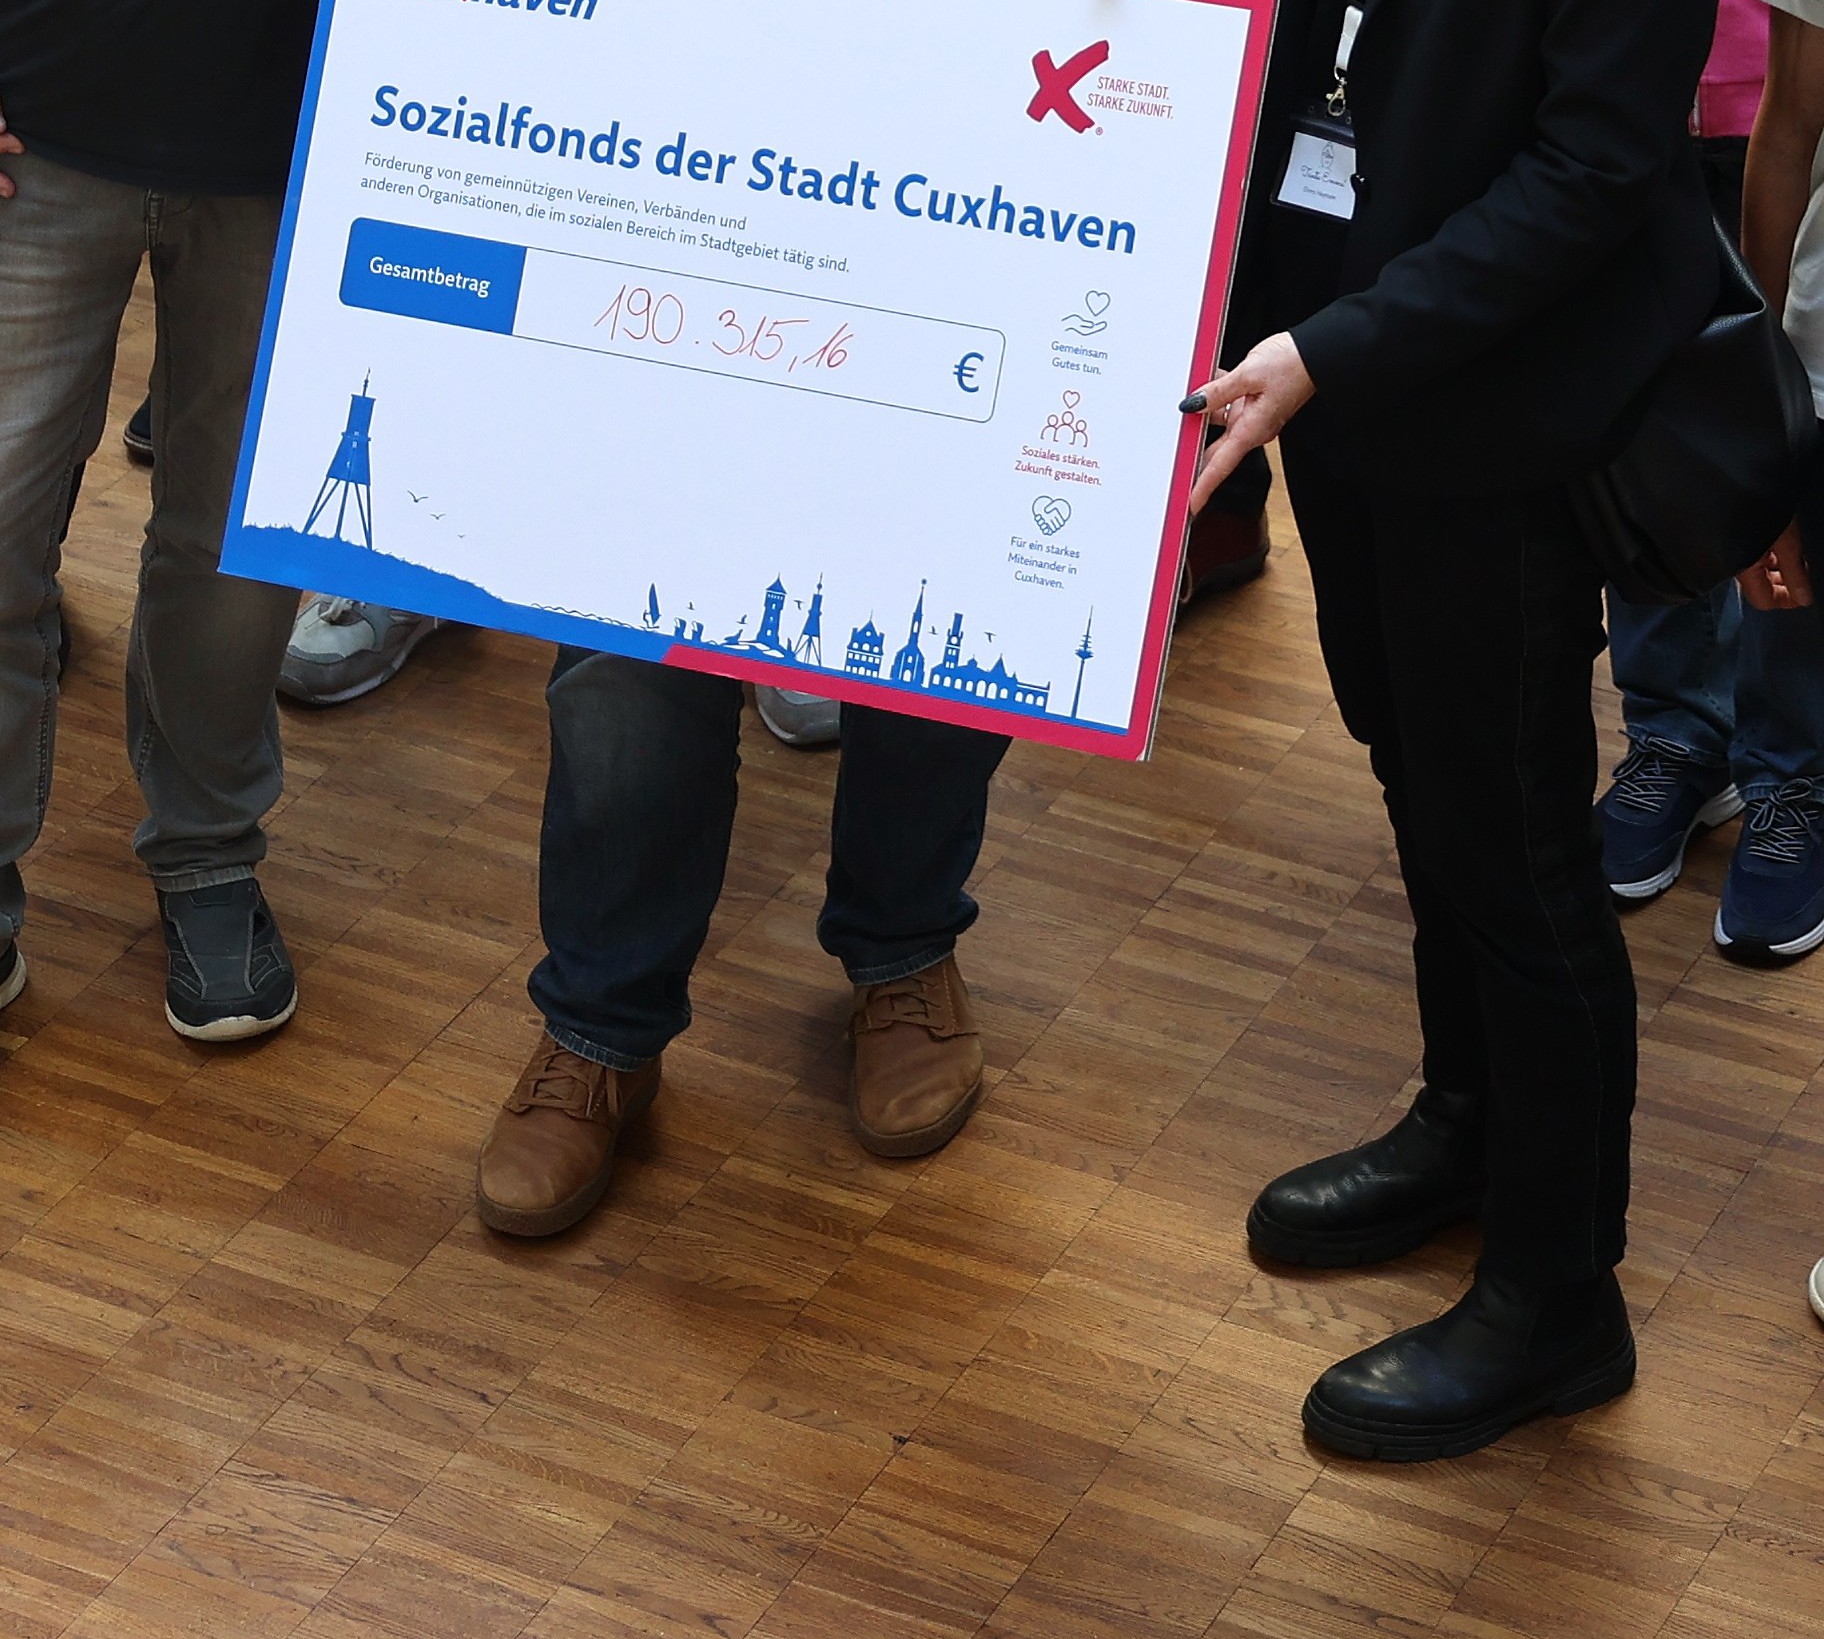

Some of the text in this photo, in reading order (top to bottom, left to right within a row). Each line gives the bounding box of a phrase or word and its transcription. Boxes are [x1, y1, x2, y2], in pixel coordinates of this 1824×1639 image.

[1097, 76, 1170, 100] STARKE STADT.
[1086, 93, 1174, 119] STARKE ZUKUNFT.
[370, 84, 1137, 254] Sozialfonds der Stadt Cuxhaven
[364, 152, 747, 231] Förderung von gemeinnützigen Vereinen, Verbänden und
[360, 176, 850, 273] anderen Organisationen, die im sozialen Bereich im Stadtgebiet tätig sind.
[370, 256, 491, 298] Gesamtbetrag
[1051, 340, 1108, 360] Gemeinsam
[953, 352, 984, 394] €
[1052, 356, 1102, 375] Gutes tun.
[1022, 446, 1100, 469] Soziales stärken.
[1014, 460, 1102, 486] Zukunft gestalten.
[1010, 536, 1080, 559] Für ein starkes
[1008, 552, 1078, 575] Miteinander in
[1014, 570, 1064, 590] Cuxhaven.
